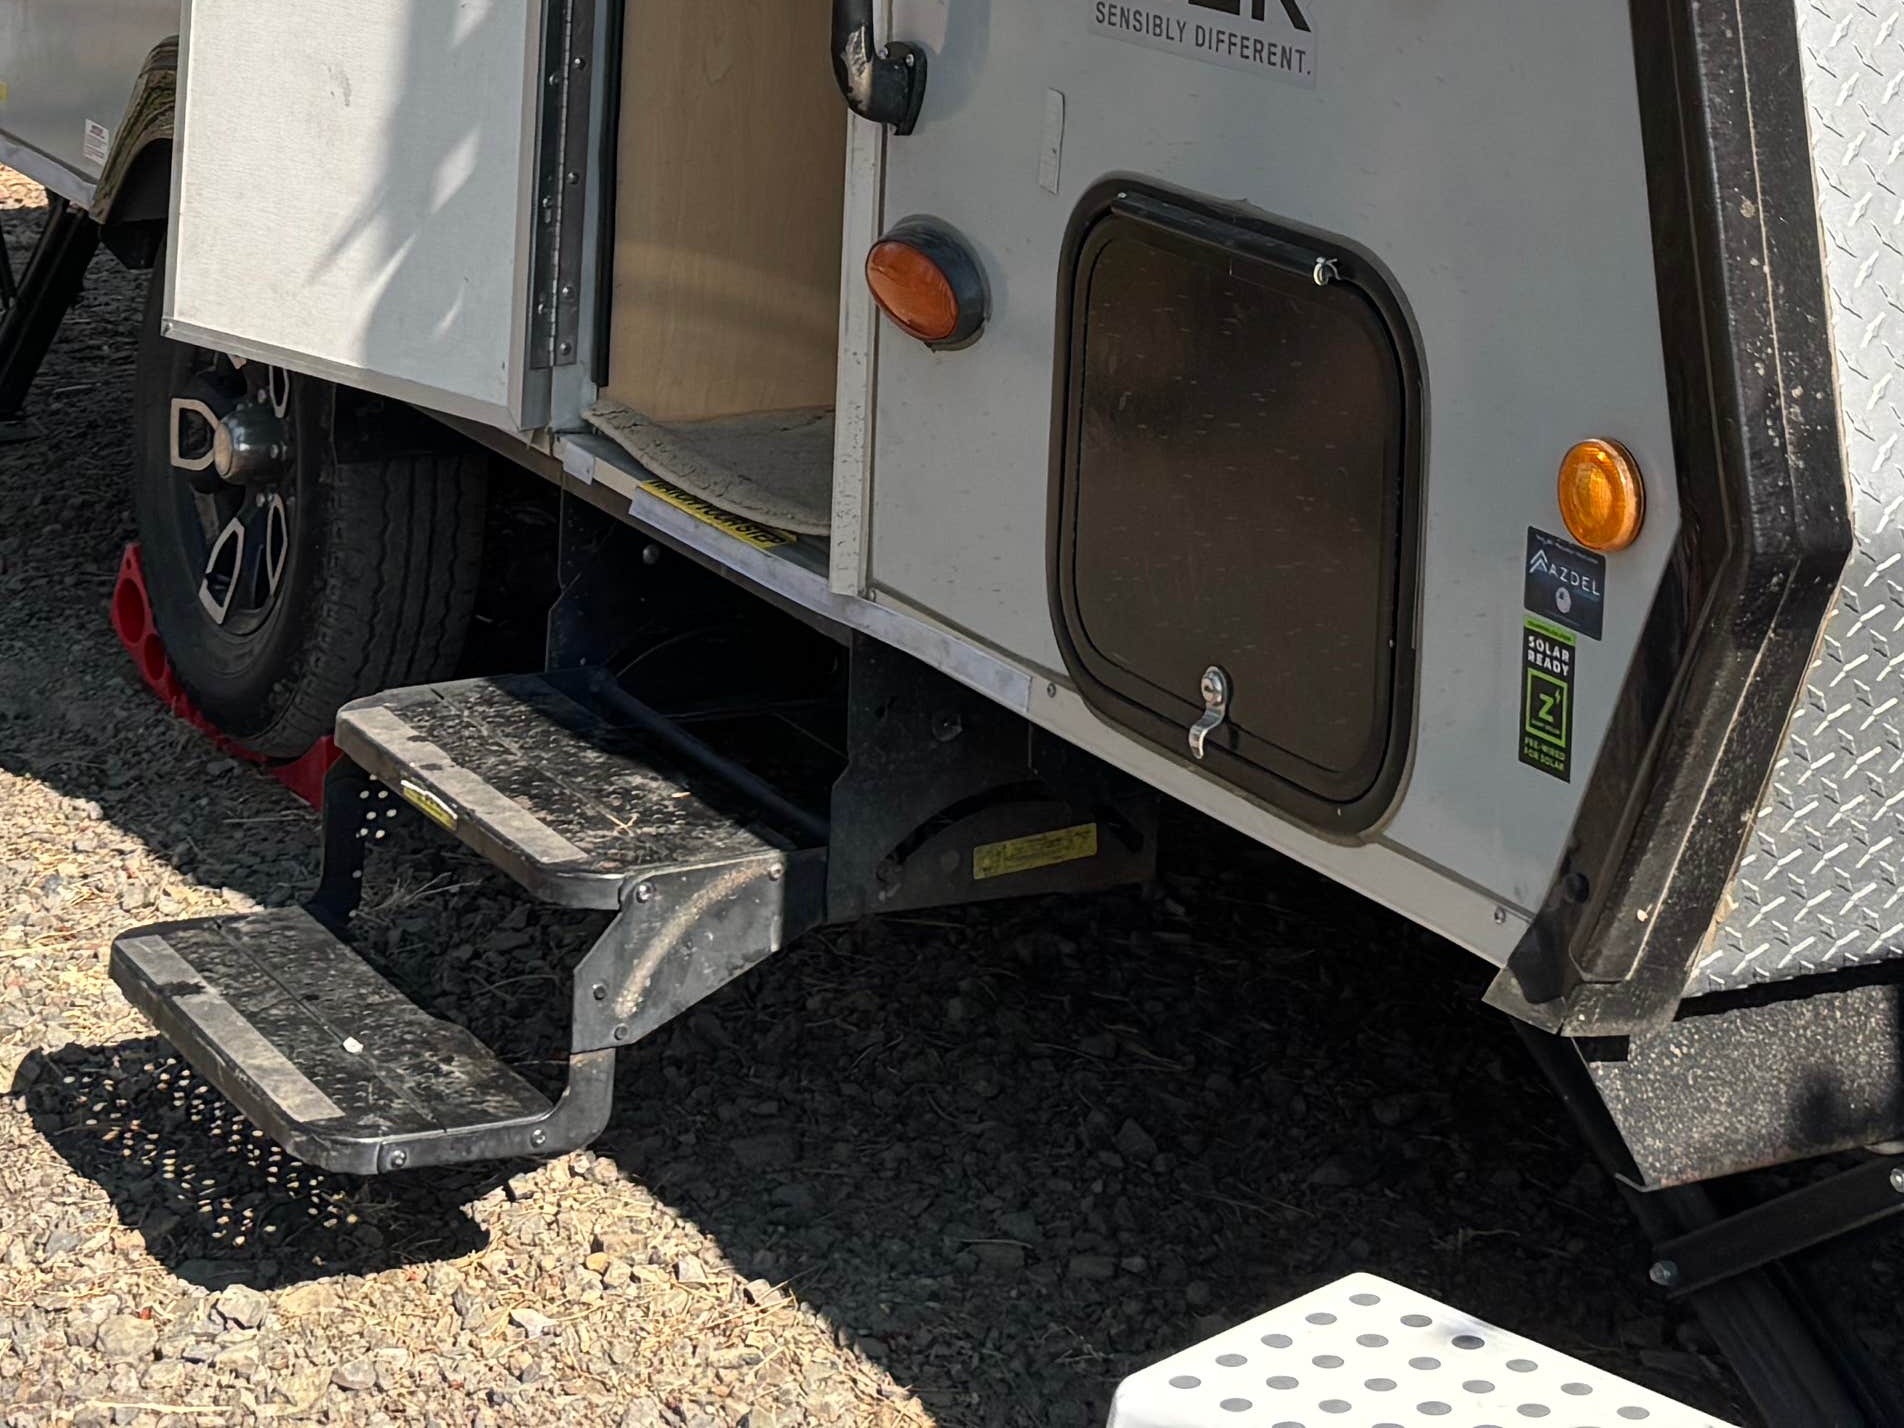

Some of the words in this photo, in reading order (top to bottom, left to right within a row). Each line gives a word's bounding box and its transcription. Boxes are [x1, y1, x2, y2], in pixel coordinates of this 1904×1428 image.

[1094, 0, 1187, 48] SENSIBLY
[1194, 24, 1312, 76] DIFFERENT.
[1527, 649, 1570, 677] READY
[1528, 635, 1570, 663] SOLAR
